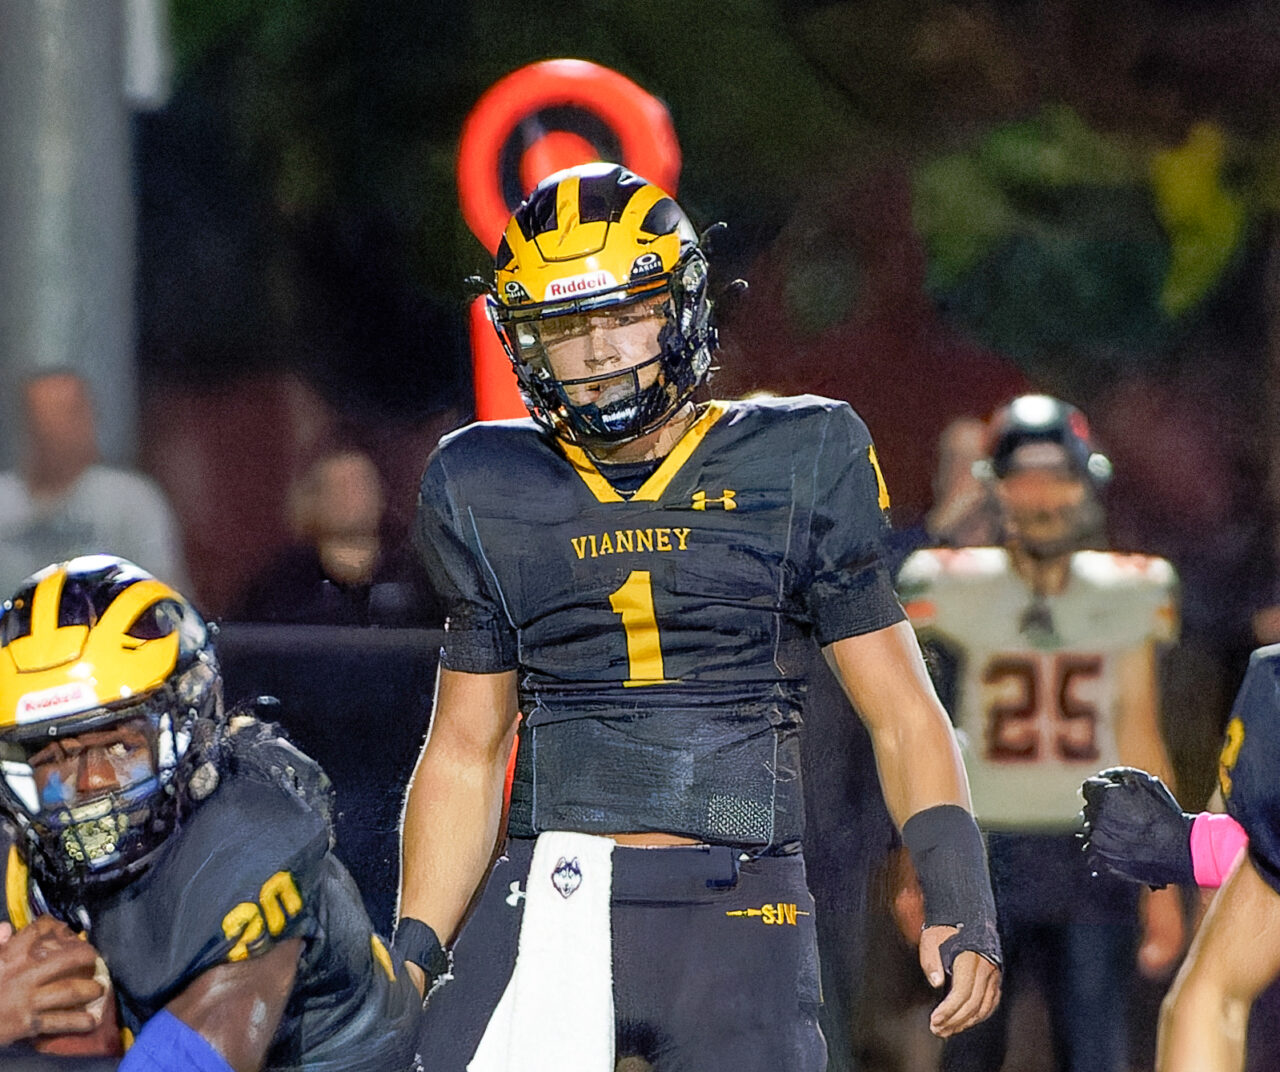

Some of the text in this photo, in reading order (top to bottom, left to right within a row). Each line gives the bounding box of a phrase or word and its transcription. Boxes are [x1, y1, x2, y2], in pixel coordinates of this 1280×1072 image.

[551, 273, 607, 296] Riddell
[571, 528, 692, 560] VIANNEY
[608, 570, 684, 688] 1
[981, 652, 1103, 763] 25
